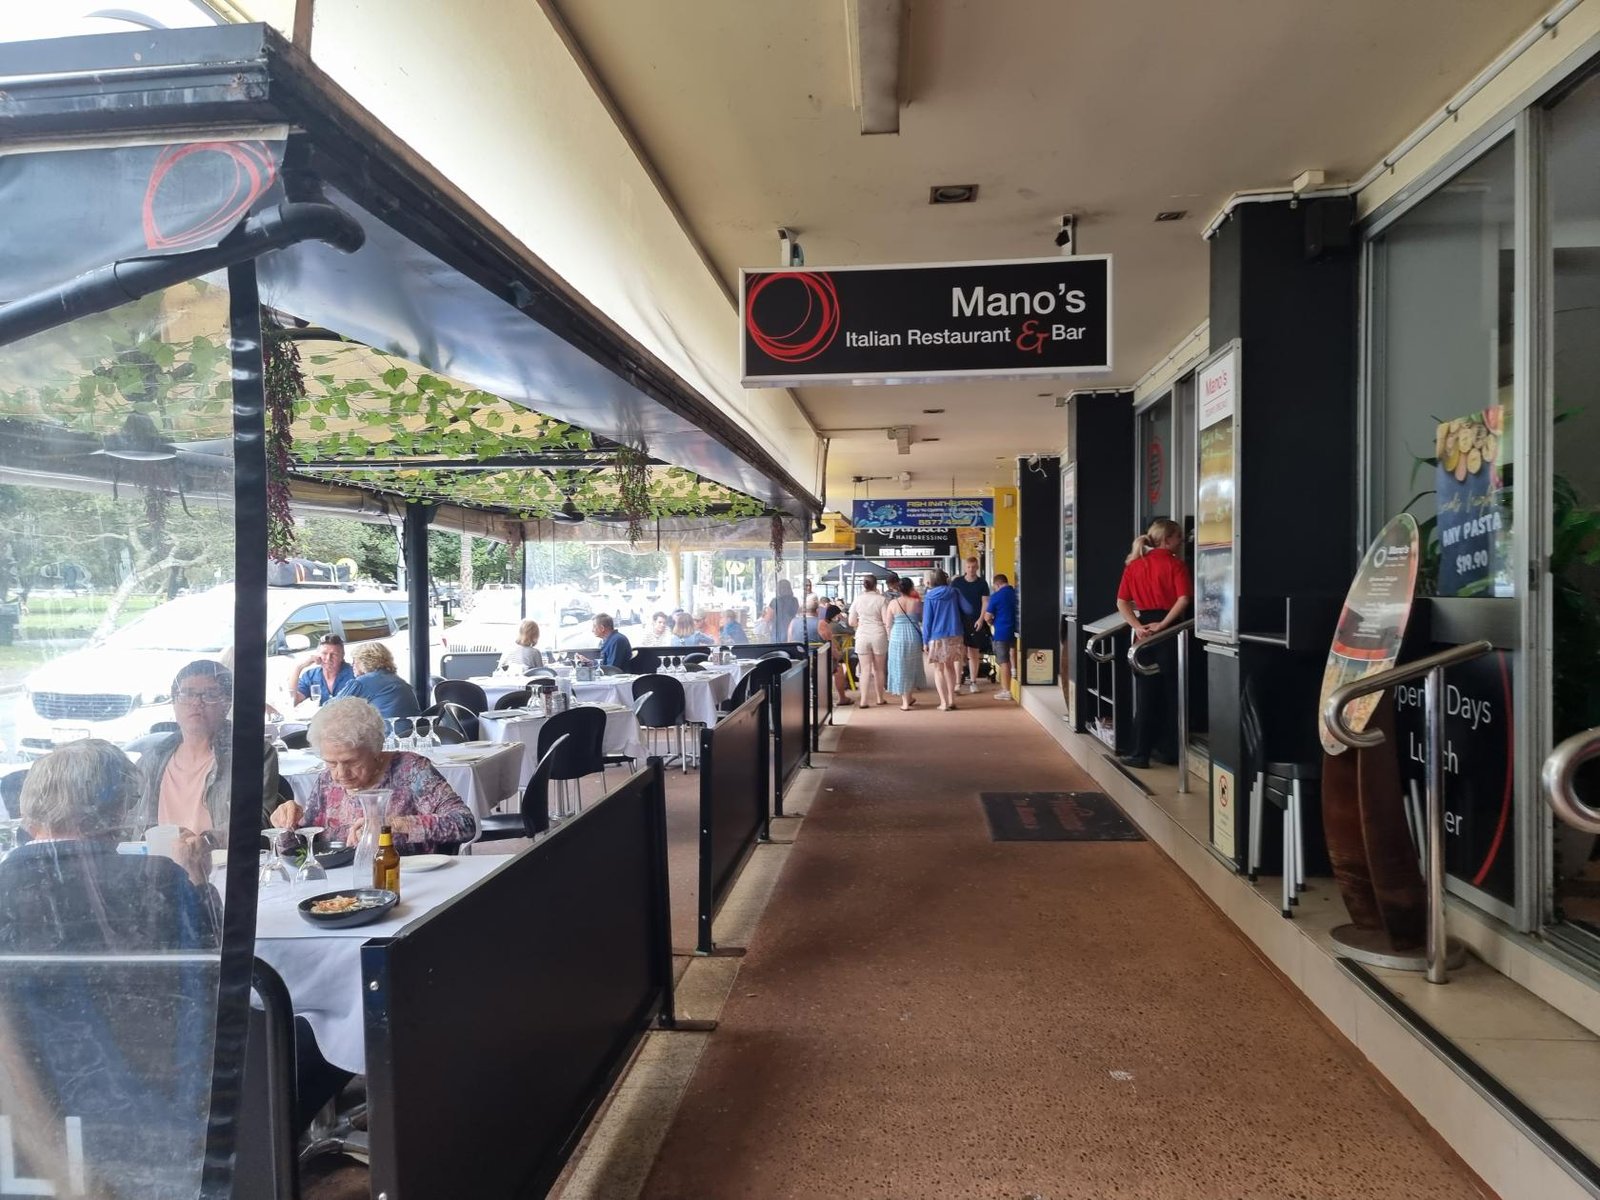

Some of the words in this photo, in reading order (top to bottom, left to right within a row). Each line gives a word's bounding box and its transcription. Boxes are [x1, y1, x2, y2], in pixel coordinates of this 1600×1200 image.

[951, 283, 1086, 318] Mano's
[846, 331, 901, 348] Italian
[907, 327, 1011, 346] Restaurant
[1016, 319, 1050, 355] &
[1052, 324, 1086, 342] Bar
[1443, 525, 1462, 547] ANY
[1463, 512, 1502, 540] PASTA
[1456, 550, 1488, 575] $19.90
[1394, 685, 1425, 711] pen
[1447, 684, 1492, 730] Days
[1410, 731, 1459, 774] Luch
